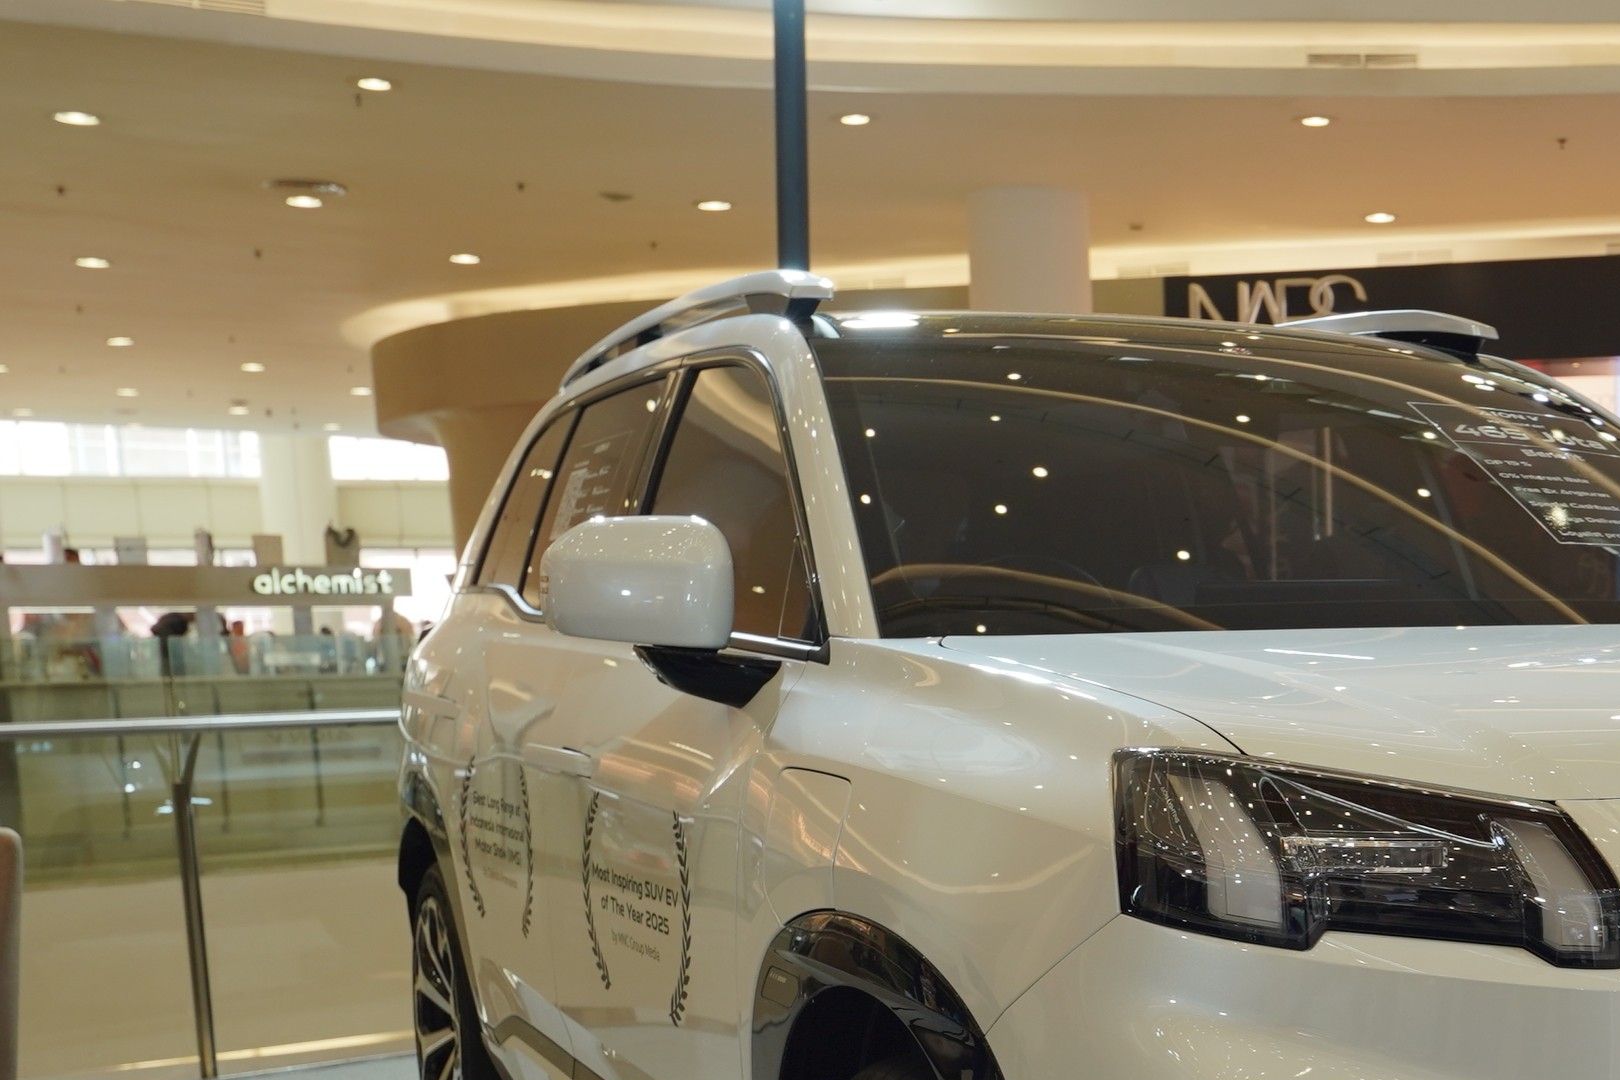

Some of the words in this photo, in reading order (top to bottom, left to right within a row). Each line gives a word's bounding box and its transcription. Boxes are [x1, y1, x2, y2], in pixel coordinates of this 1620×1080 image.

[1455, 424, 1531, 441] 465
[252, 567, 393, 595] alchemist
[592, 862, 611, 884] Most
[611, 868, 643, 901] Inspiring
[644, 881, 664, 903] SUV
[665, 887, 679, 908] EV
[601, 895, 609, 911] of
[610, 896, 625, 918] The
[626, 902, 645, 925] Year
[645, 910, 670, 936] 2025
